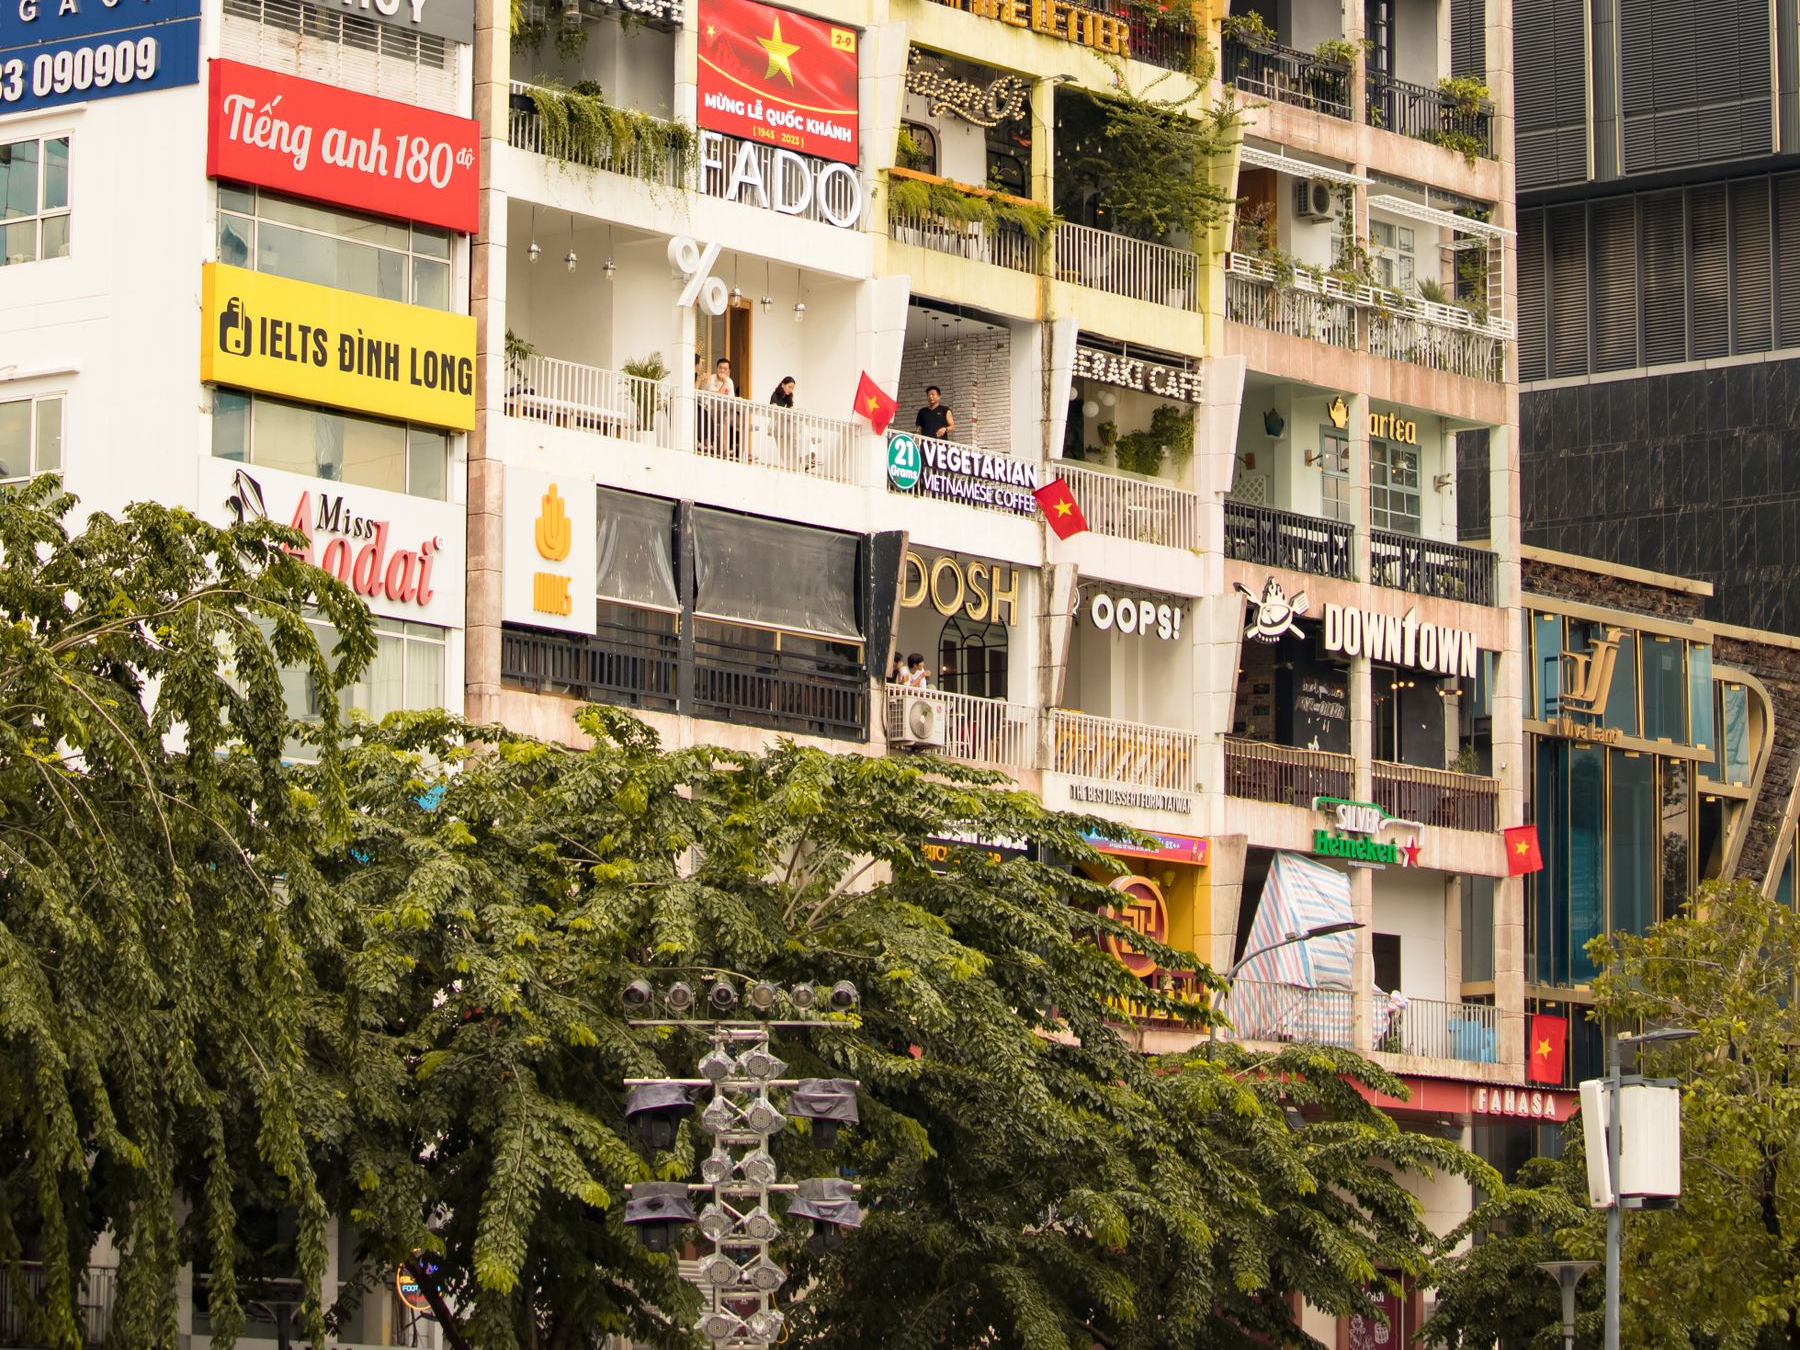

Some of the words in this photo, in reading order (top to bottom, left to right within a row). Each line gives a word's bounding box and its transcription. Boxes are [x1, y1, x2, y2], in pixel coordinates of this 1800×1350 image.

[32, 36, 159, 98] 090909
[704, 92, 745, 116] MỪNG
[766, 109, 803, 130] QUỐC
[806, 118, 852, 143] KHÁNH
[223, 93, 313, 172] Tiếng
[393, 133, 454, 190] 180
[700, 130, 862, 228] FADO
[259, 316, 328, 368] IELTS
[338, 328, 400, 382] ĐÌNH
[411, 346, 473, 396] LONG
[1369, 412, 1417, 445] artea
[890, 463, 918, 481] Grams
[894, 438, 914, 467] 21
[922, 440, 1038, 489] VEGETARIAN
[923, 470, 992, 504] VIETNAMESE
[995, 490, 1037, 514] COFFEE
[315, 493, 376, 539] Miss
[901, 550, 1019, 627] DOSH
[1090, 593, 1181, 641] OOPS!
[1324, 602, 1478, 679] DOWNTOWN
[1560, 715, 1589, 742] Viva
[1590, 723, 1623, 745] Land
[1336, 803, 1380, 835] SILVER
[1313, 828, 1397, 864] Heineken
[1477, 1088, 1556, 1117] FAHASA
